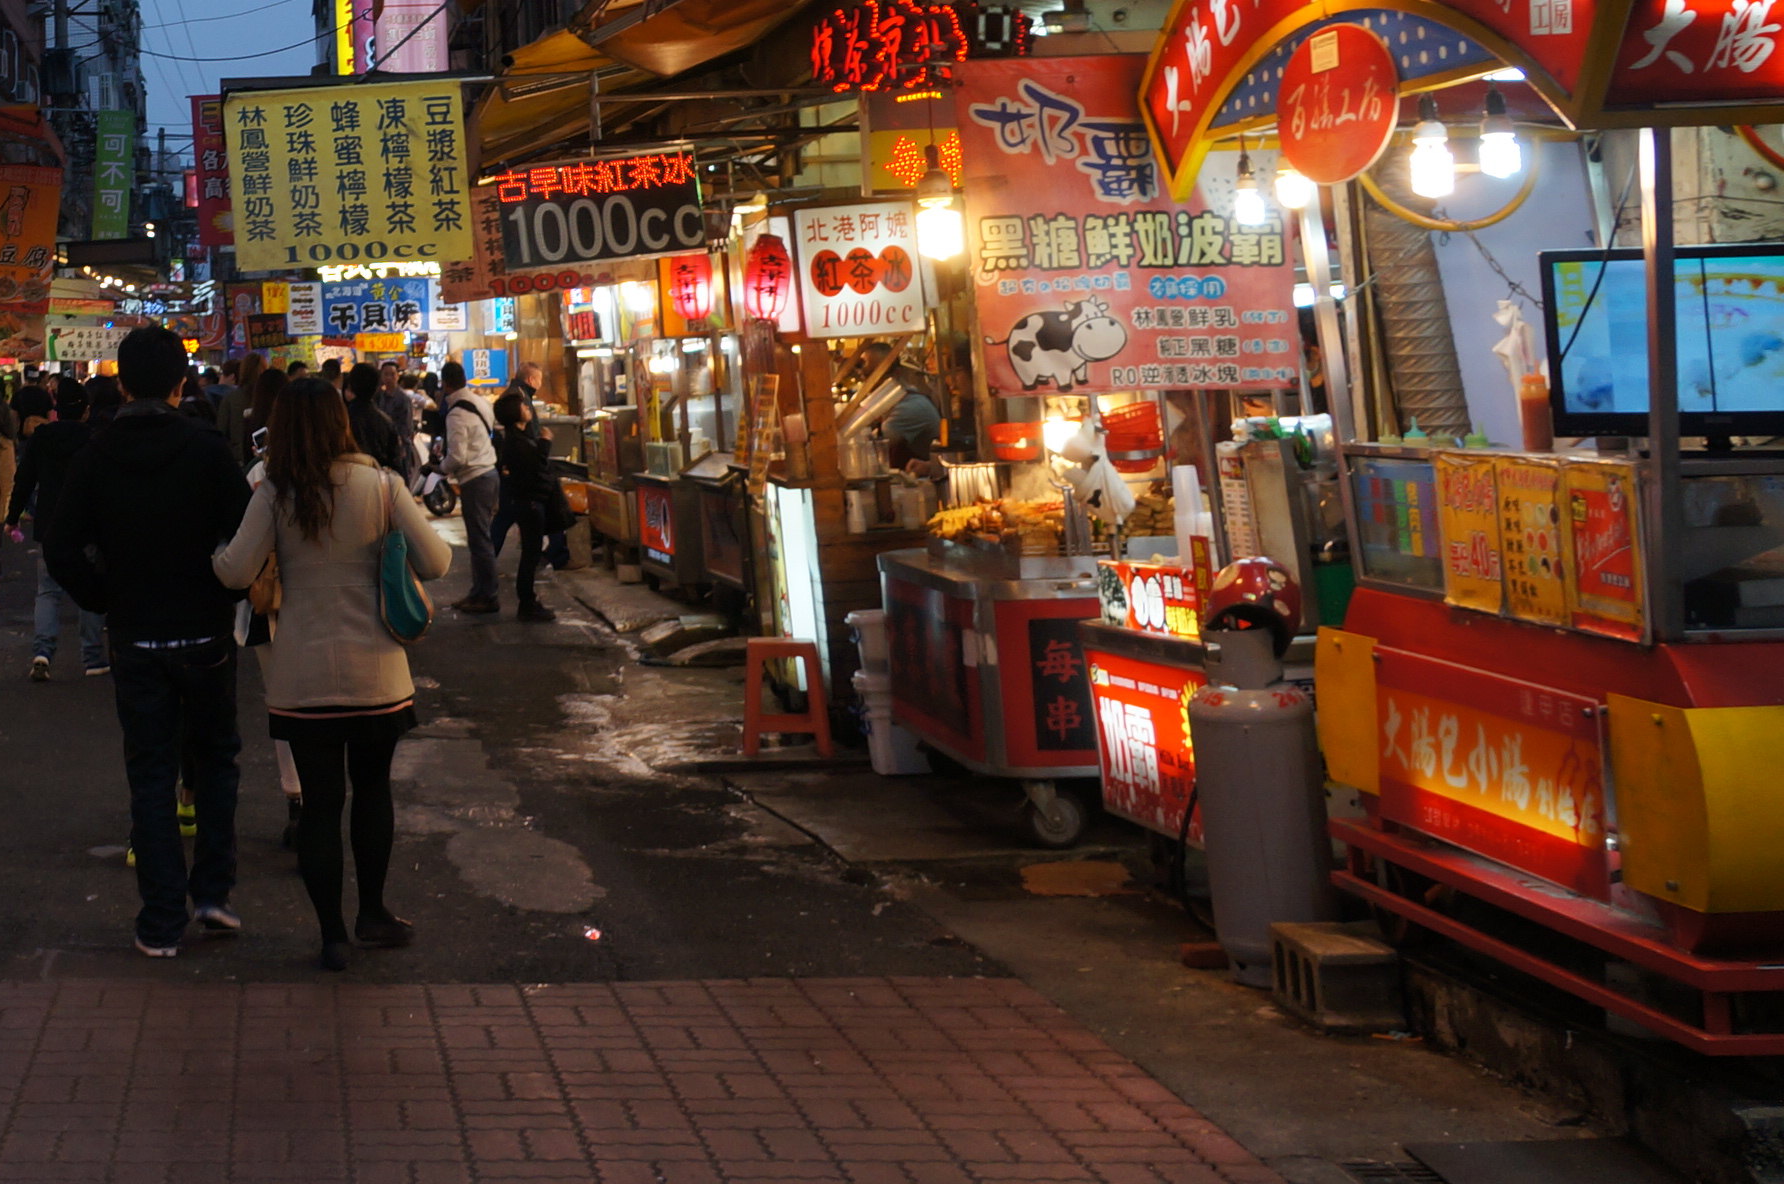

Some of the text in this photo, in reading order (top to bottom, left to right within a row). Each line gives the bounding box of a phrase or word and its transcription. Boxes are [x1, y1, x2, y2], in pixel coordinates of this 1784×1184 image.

[99, 133, 129, 216] 可不可
[237, 106, 277, 243] 林鳳營鮮奶茶
[283, 104, 324, 239] 珍珠鮮奶茶
[329, 100, 372, 238] 蜂蜜檸檬
[376, 98, 417, 237] 凍檸檬茶
[422, 95, 464, 234] 豆漿紅茶
[495, 152, 695, 203] 古早味紅茶冰
[283, 239, 438, 265] 1000cc
[506, 195, 706, 264] 1000cc
[806, 205, 909, 244] 北港阿嬤
[979, 211, 1284, 273] 黑糖鮮奶波霸
[814, 251, 910, 292] 紅茶冰
[329, 302, 422, 331] 干貝燒
[820, 301, 914, 330] 1000cc
[1035, 638, 1083, 742] 每串
[1384, 695, 1532, 812] 大腸包小腸
